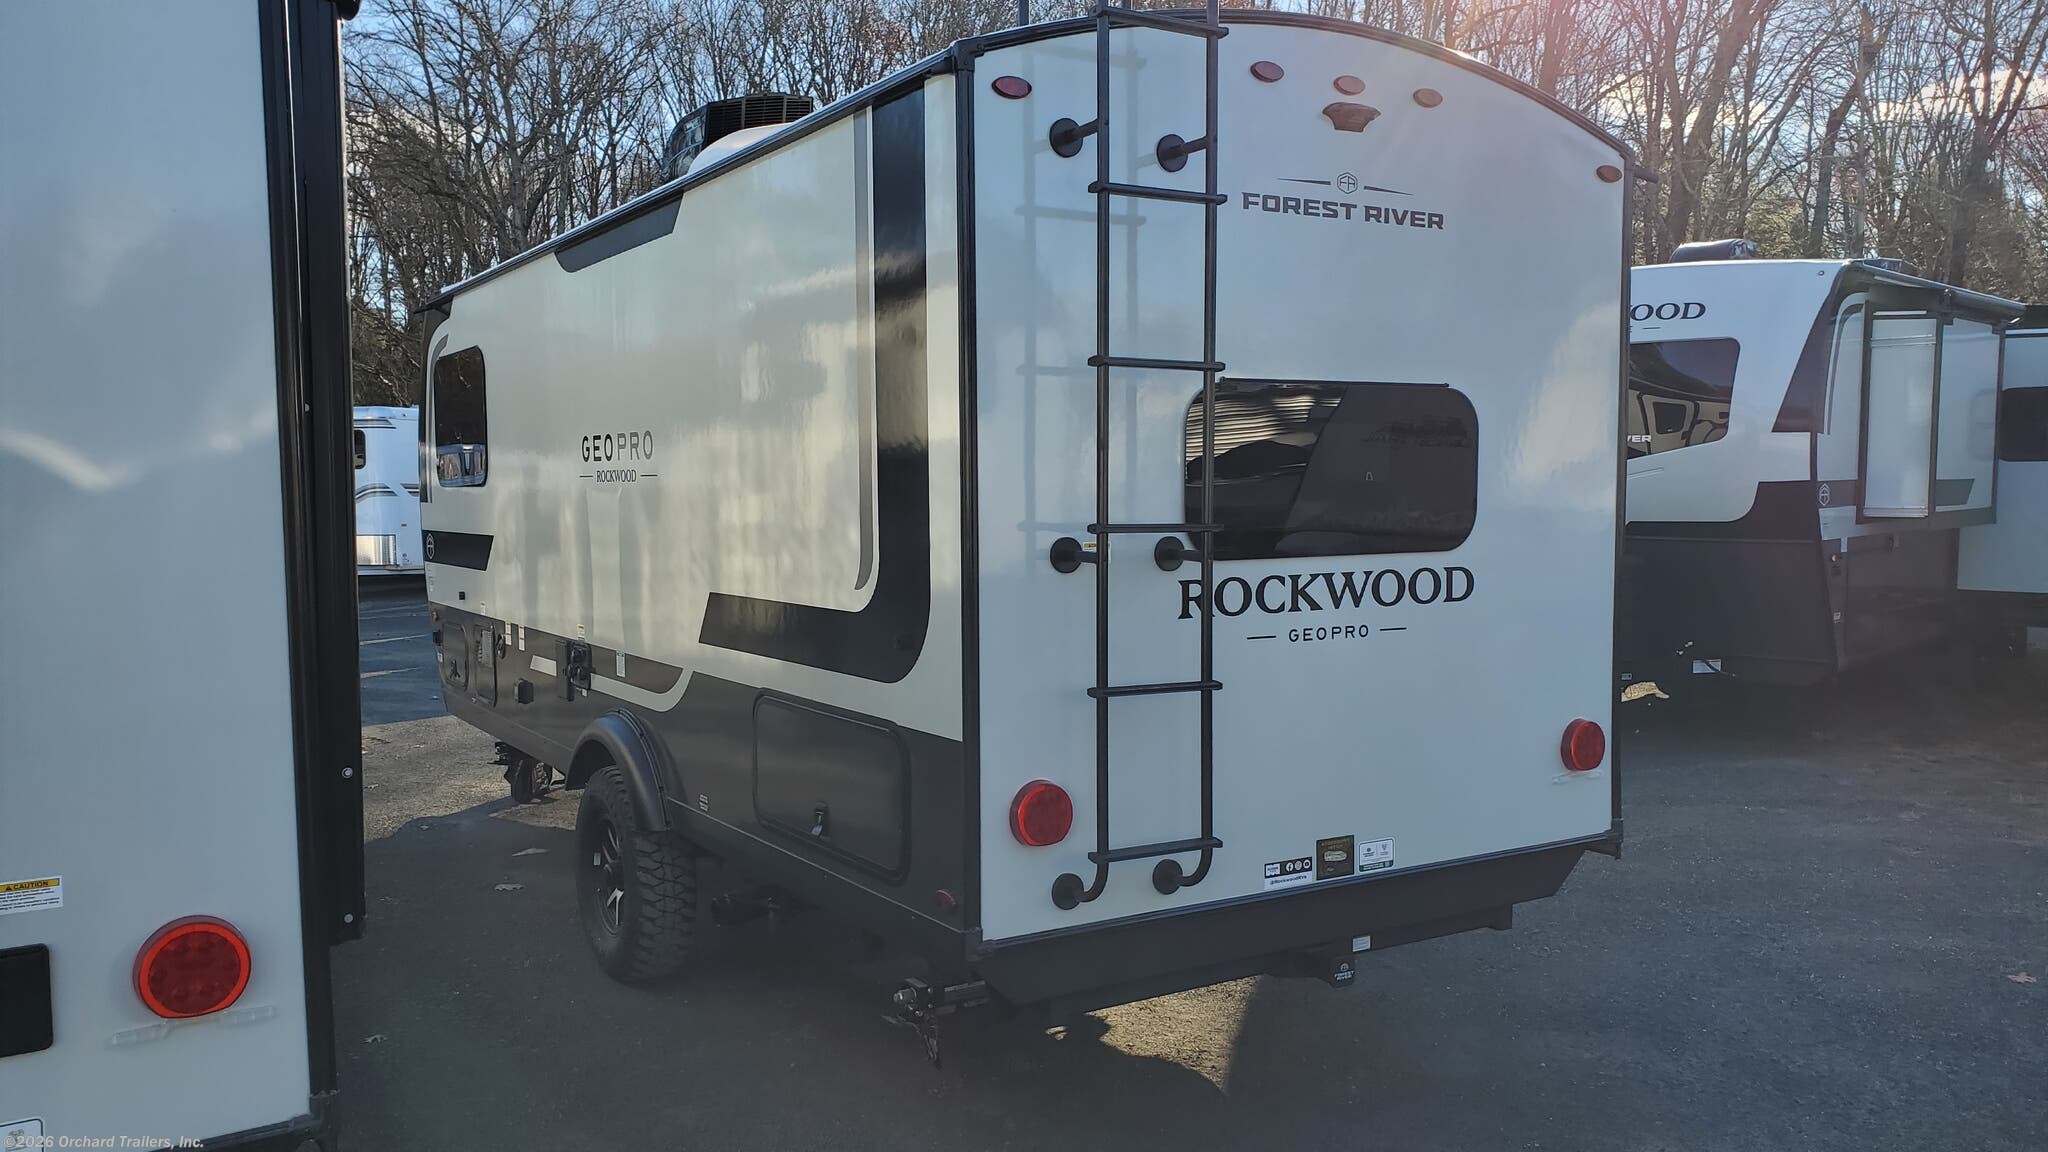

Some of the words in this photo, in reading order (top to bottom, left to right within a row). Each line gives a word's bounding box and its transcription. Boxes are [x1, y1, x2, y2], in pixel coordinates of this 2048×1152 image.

[1241, 191, 1357, 220] FOREST
[1363, 205, 1444, 230] RIVER
[1630, 302, 1706, 321] OOD
[581, 430, 654, 463] GEOPRO
[596, 468, 637, 484] ROCKWOOD
[1178, 566, 1475, 620] ROCKWOOD
[1288, 624, 1370, 643] GEOPRO
[13, 880, 49, 890] CAUTION
